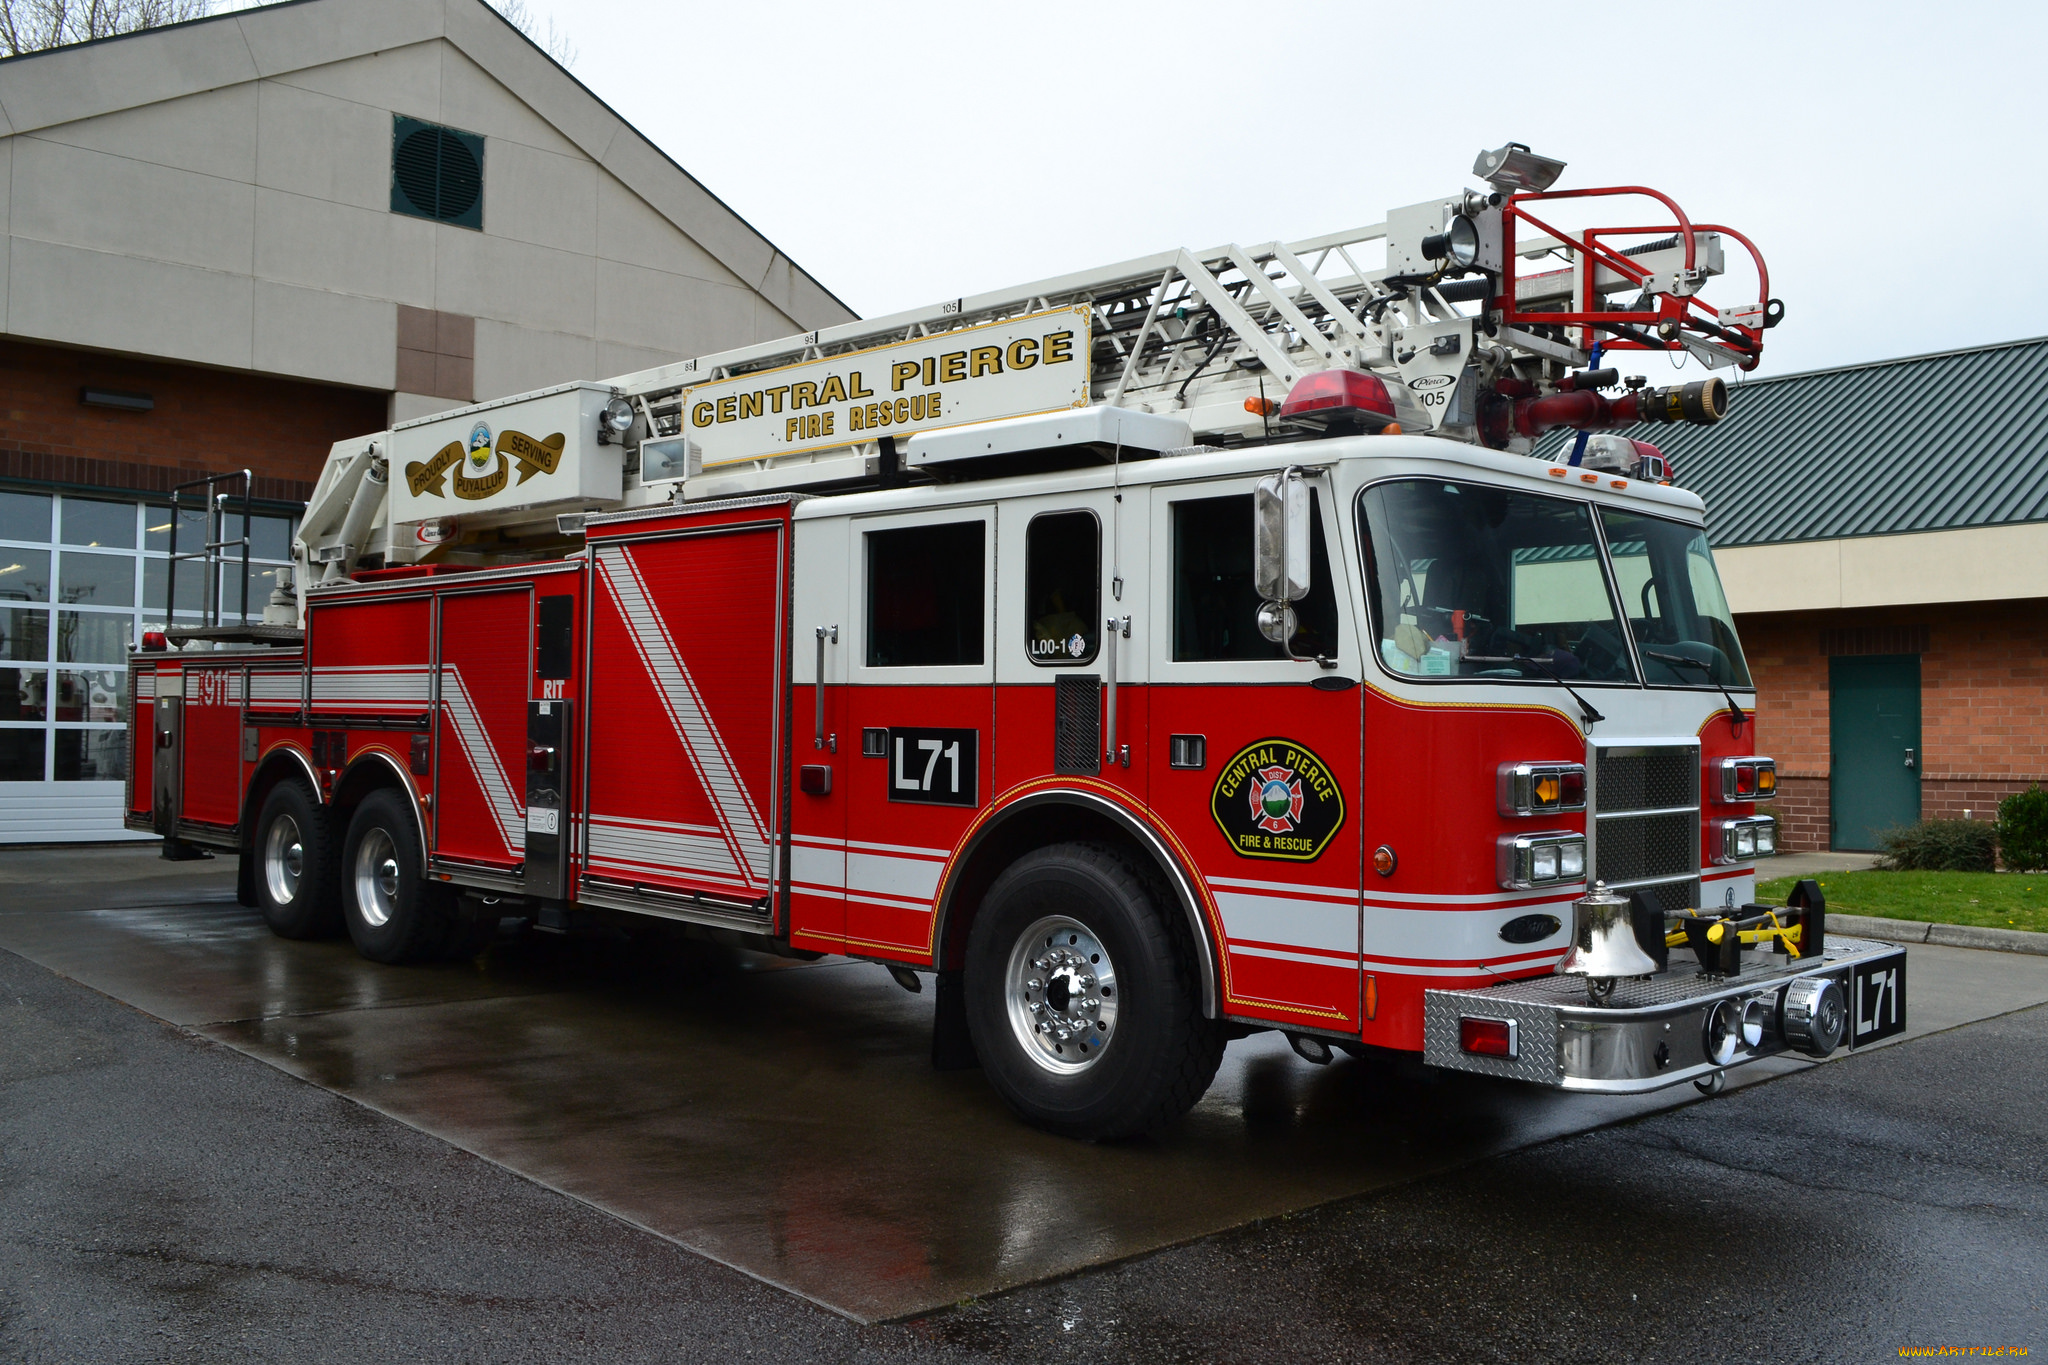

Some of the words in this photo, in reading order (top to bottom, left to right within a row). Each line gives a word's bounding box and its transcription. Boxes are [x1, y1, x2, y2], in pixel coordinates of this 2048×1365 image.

[942, 303, 957, 314] 105
[804, 335, 814, 344] 95
[684, 363, 693, 372] 85
[692, 371, 874, 428] CENTRAL
[891, 330, 1073, 392] PIERCE
[1419, 391, 1445, 407] 105
[785, 411, 835, 442] FIRE
[850, 392, 942, 432] RESCUE
[413, 449, 451, 492] PROUDLY
[511, 435, 552, 468] SERVING
[457, 470, 504, 493] PUYALLUP
[205, 670, 229, 706] 911
[543, 679, 566, 699] RIT
[895, 737, 959, 793] L71
[1221, 747, 1278, 798] CENTRAL
[1285, 749, 1333, 802] PIERCE
[1272, 821, 1278, 829] 6
[1240, 834, 1261, 848] FIRE
[1263, 836, 1271, 849] &
[1274, 837, 1313, 852] RESCUE
[1856, 967, 1896, 1036] L71
